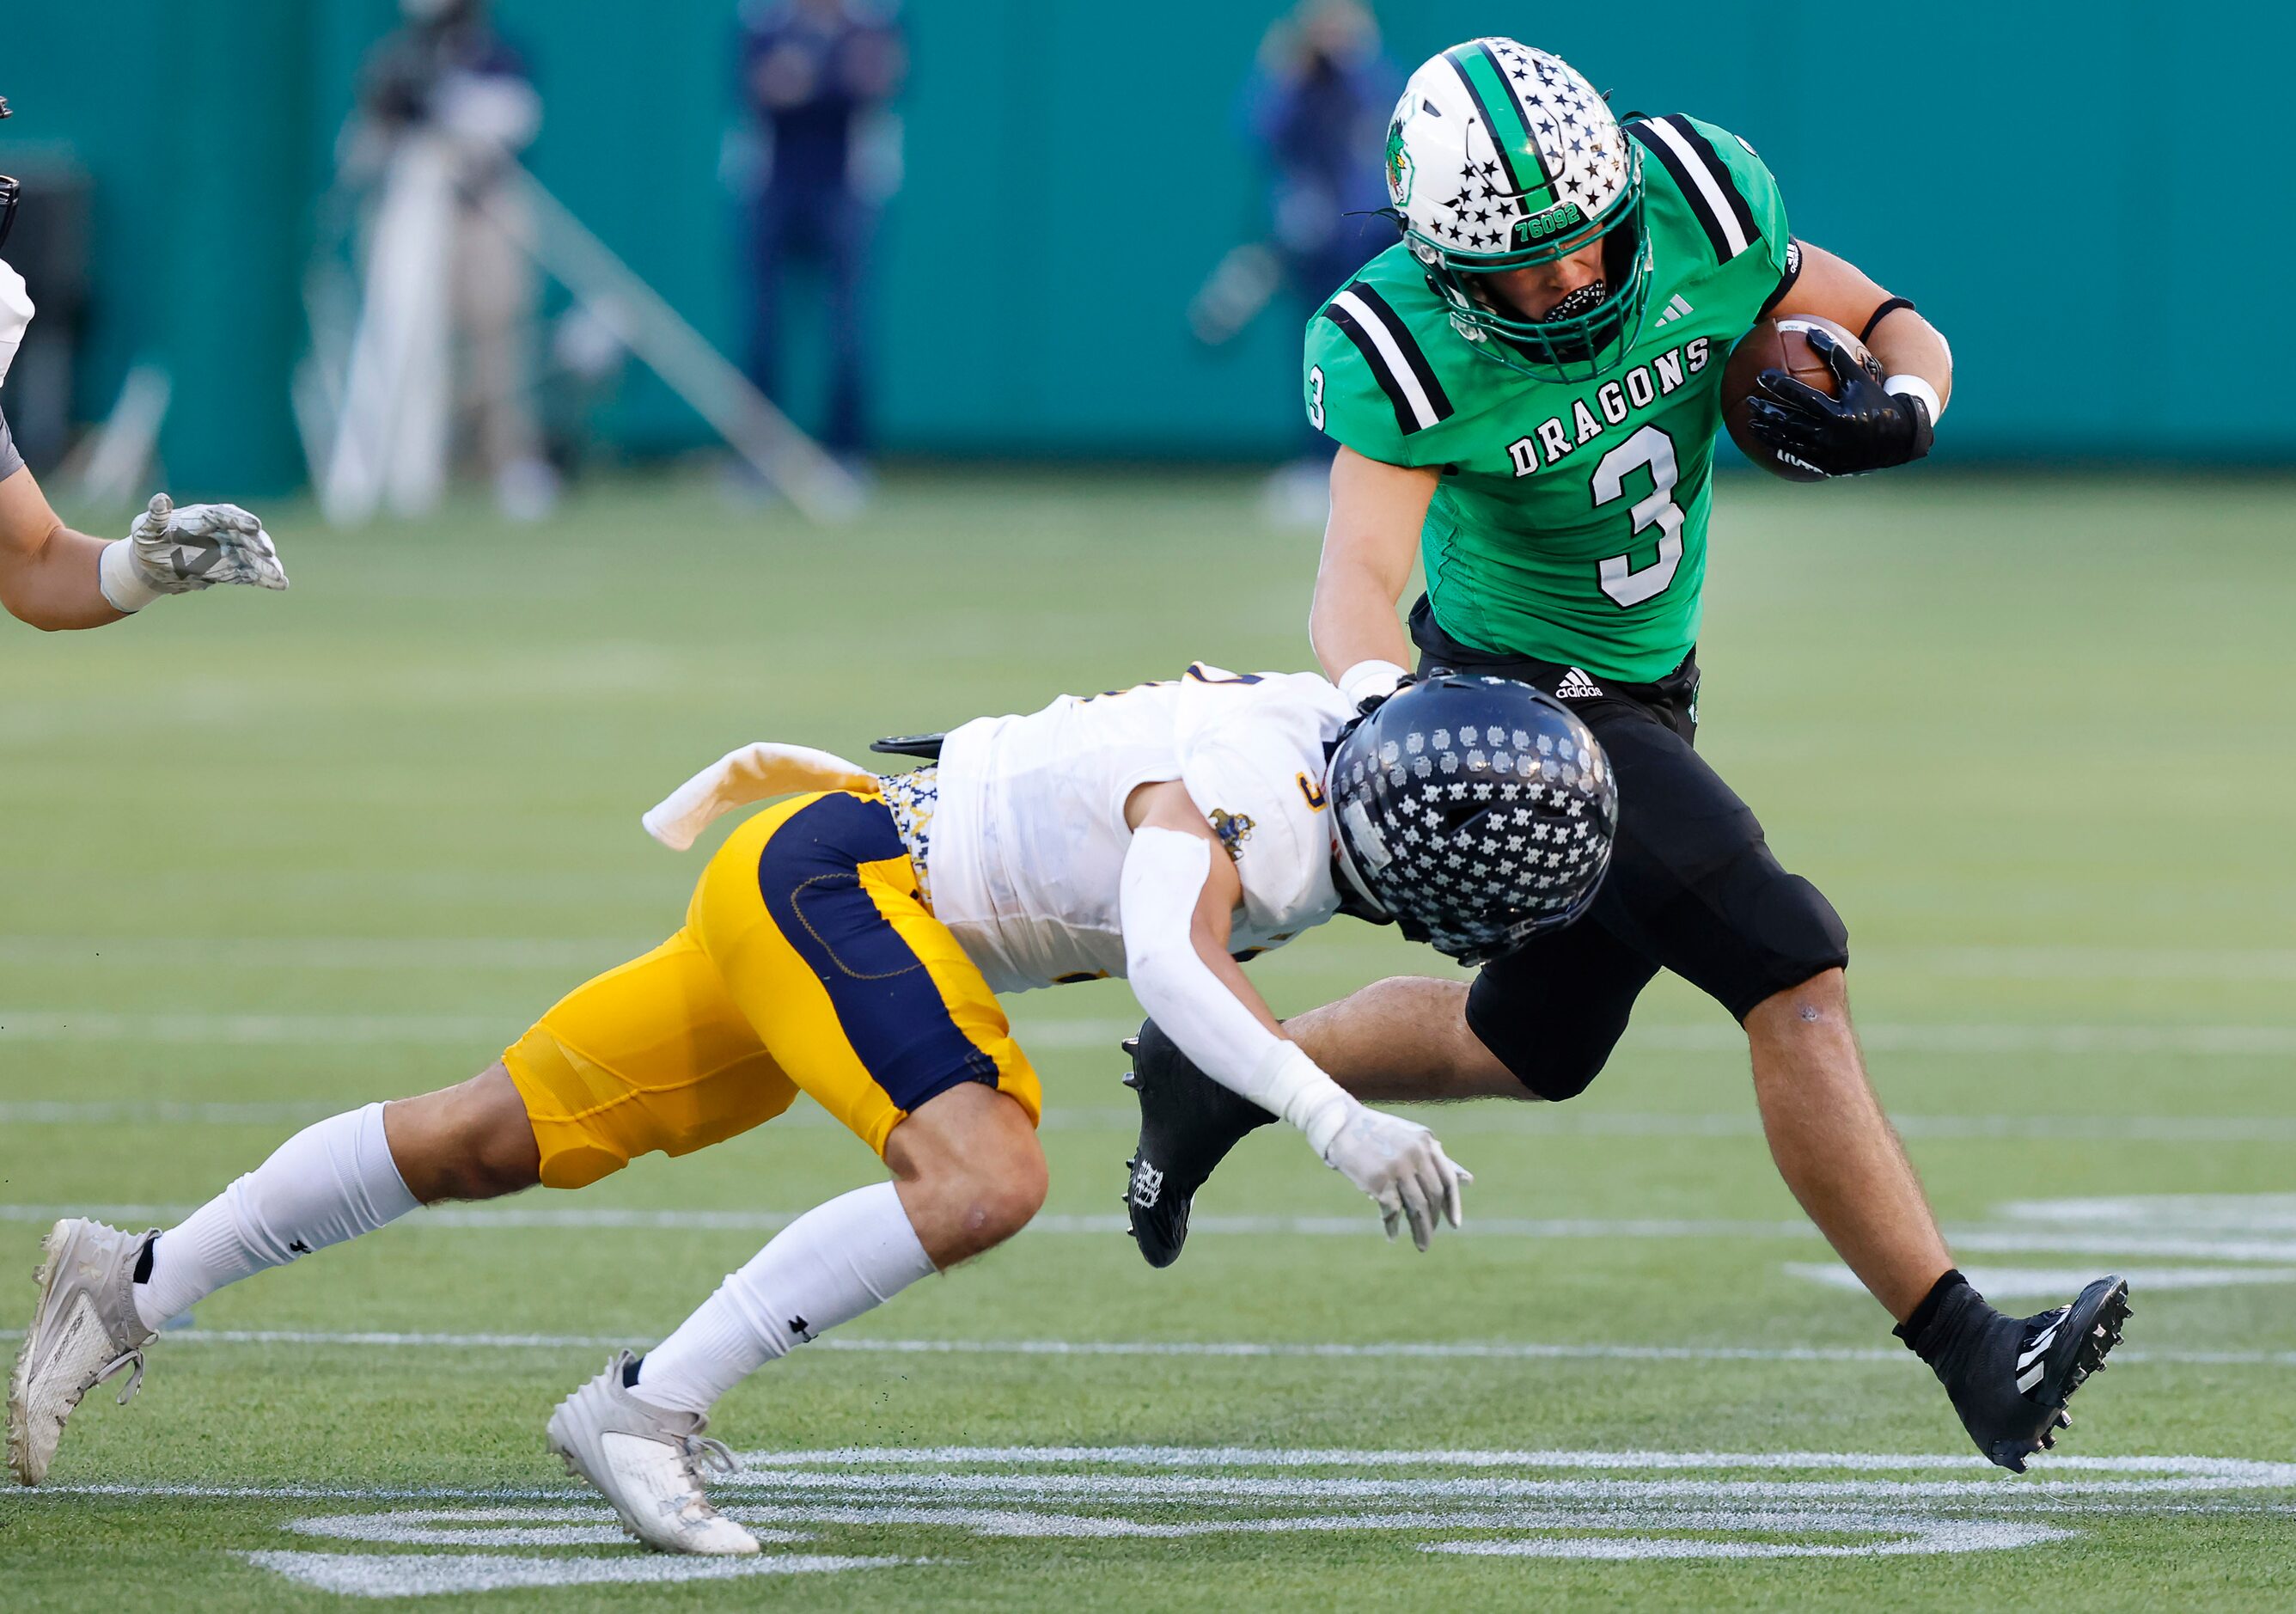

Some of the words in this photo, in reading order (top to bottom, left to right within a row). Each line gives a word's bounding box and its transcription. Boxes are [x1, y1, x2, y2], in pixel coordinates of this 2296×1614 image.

[1514, 203, 1581, 242] 76092
[1309, 364, 1326, 431] 3
[1505, 336, 1710, 479] DRAGONS
[1589, 422, 1686, 610] 3
[1555, 683, 1603, 699] adidas
